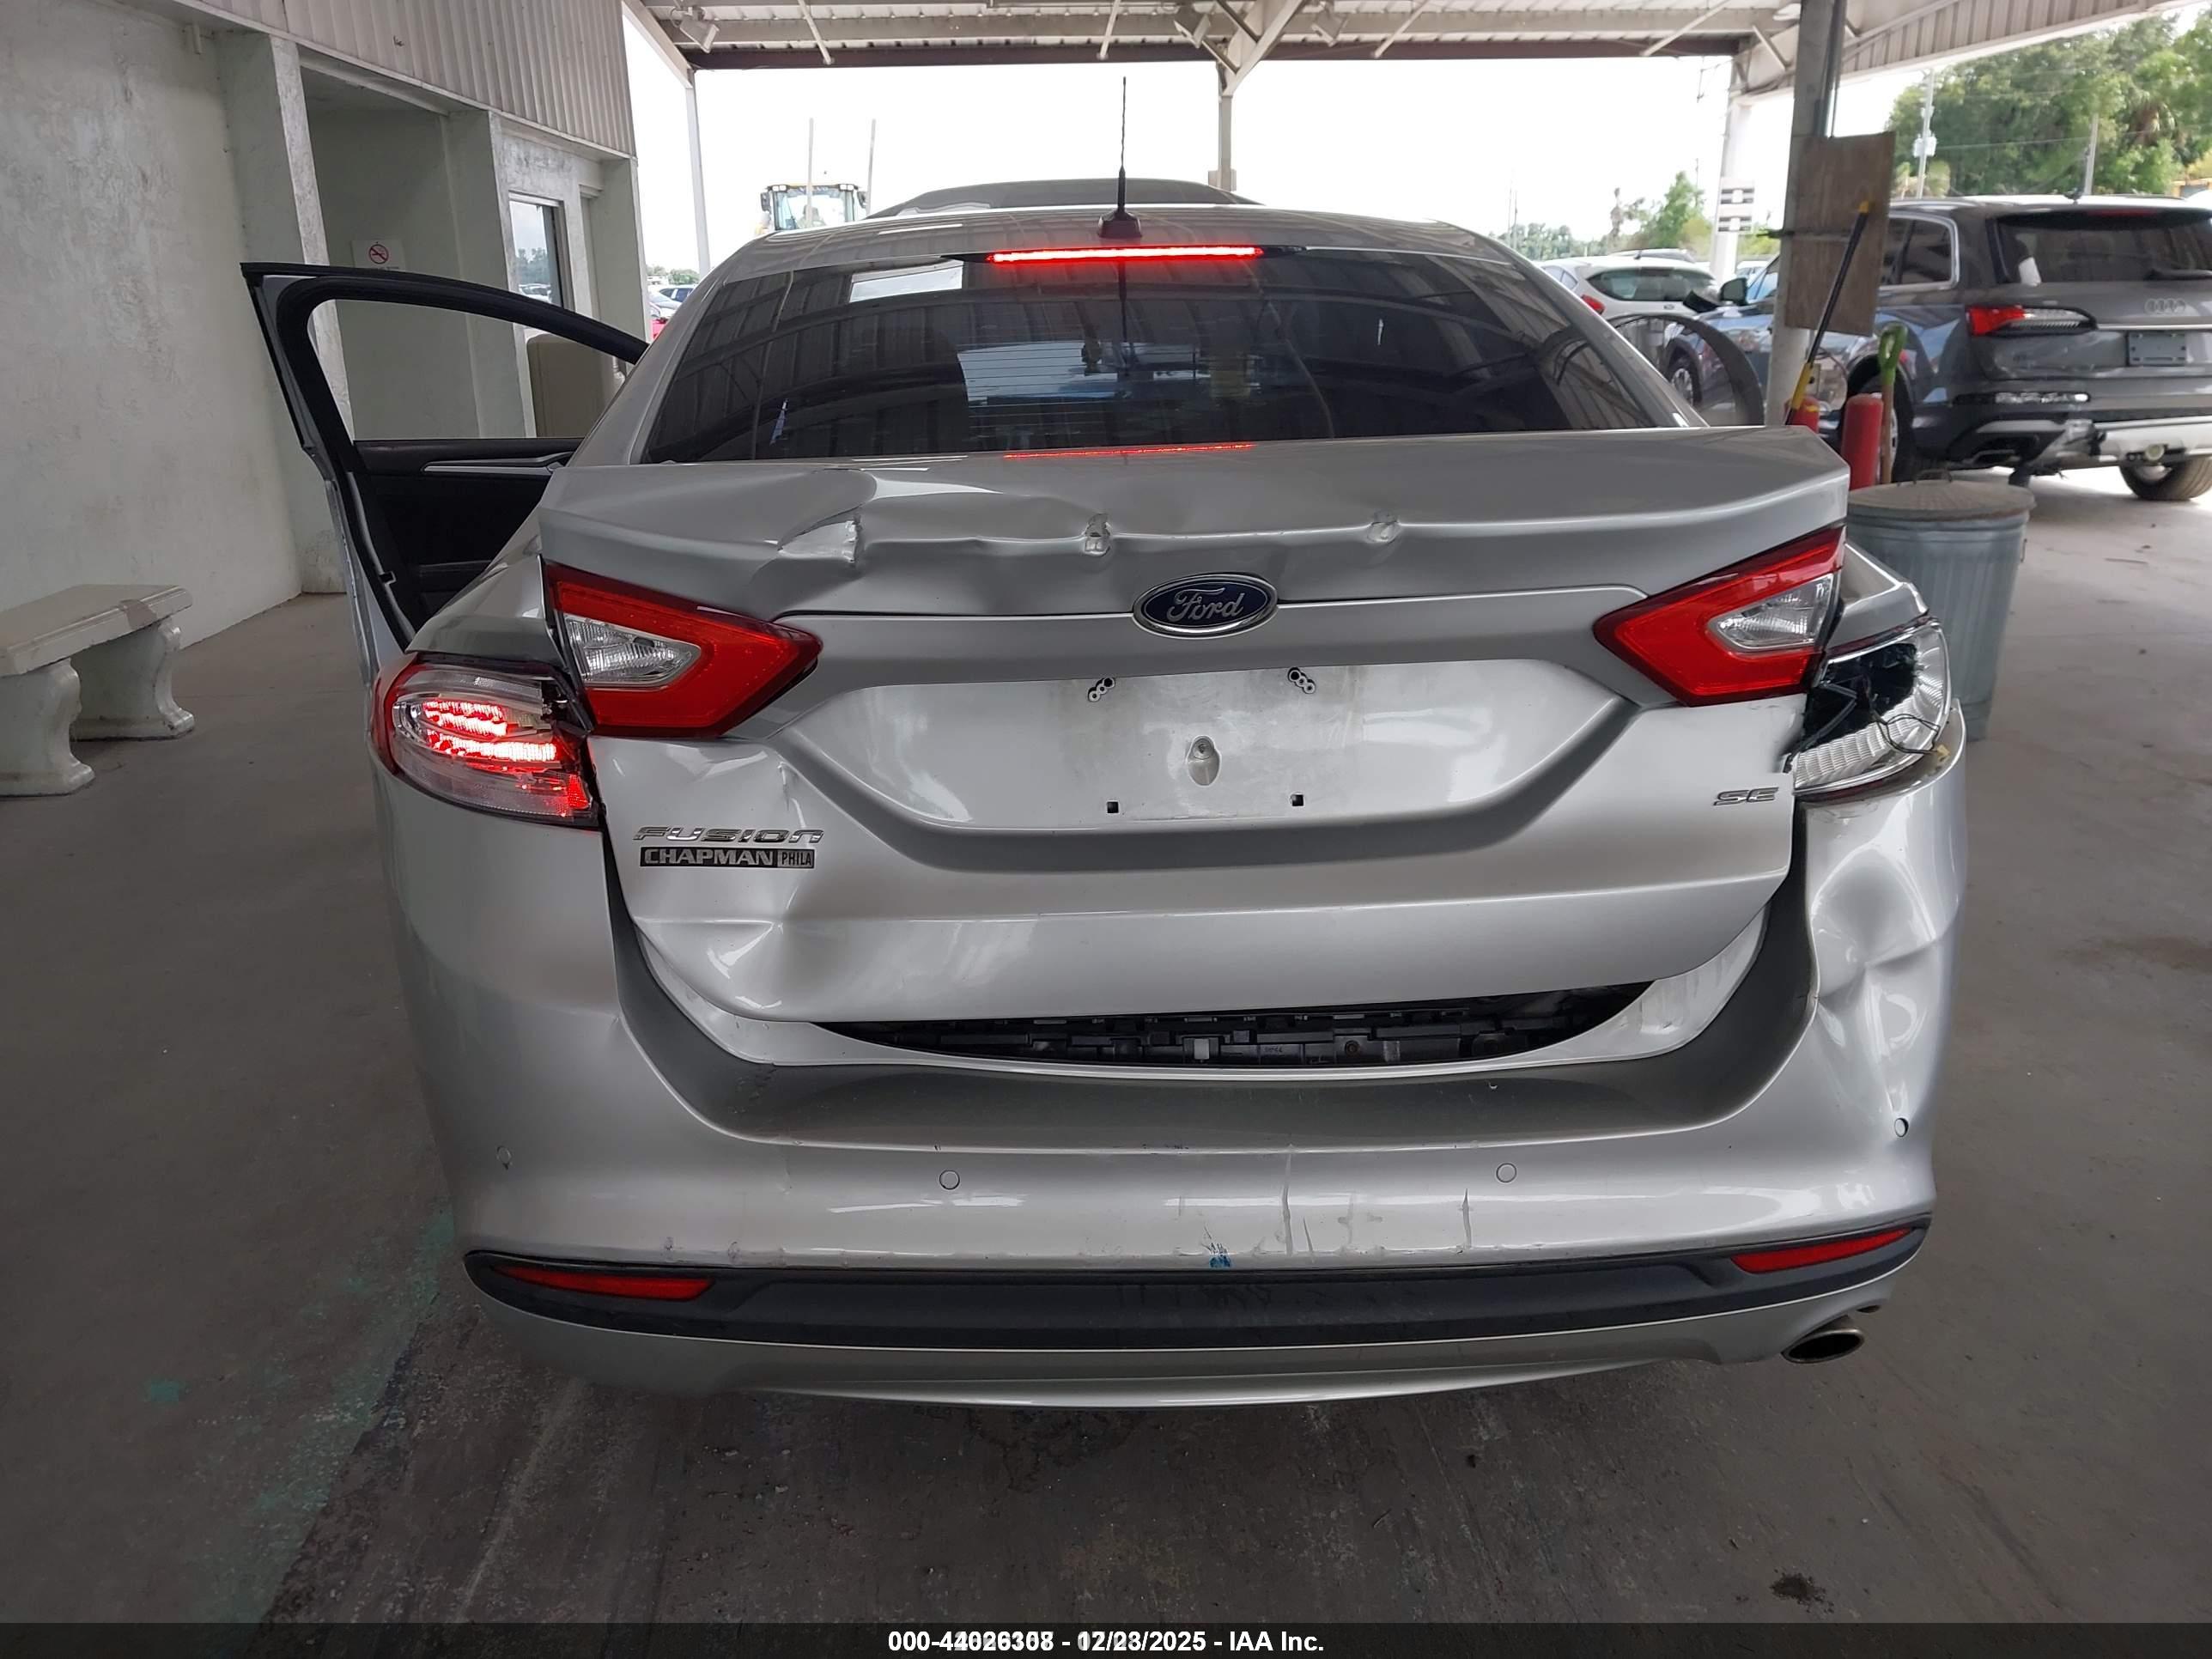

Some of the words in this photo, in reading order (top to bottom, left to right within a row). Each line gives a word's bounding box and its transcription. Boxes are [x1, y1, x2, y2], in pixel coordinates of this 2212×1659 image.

[1166, 587, 1245, 622] Ford
[1713, 787, 1779, 806] SE
[631, 826, 824, 844] FUSION
[644, 848, 774, 866] CHAPMAN
[781, 850, 812, 867] PHILA
